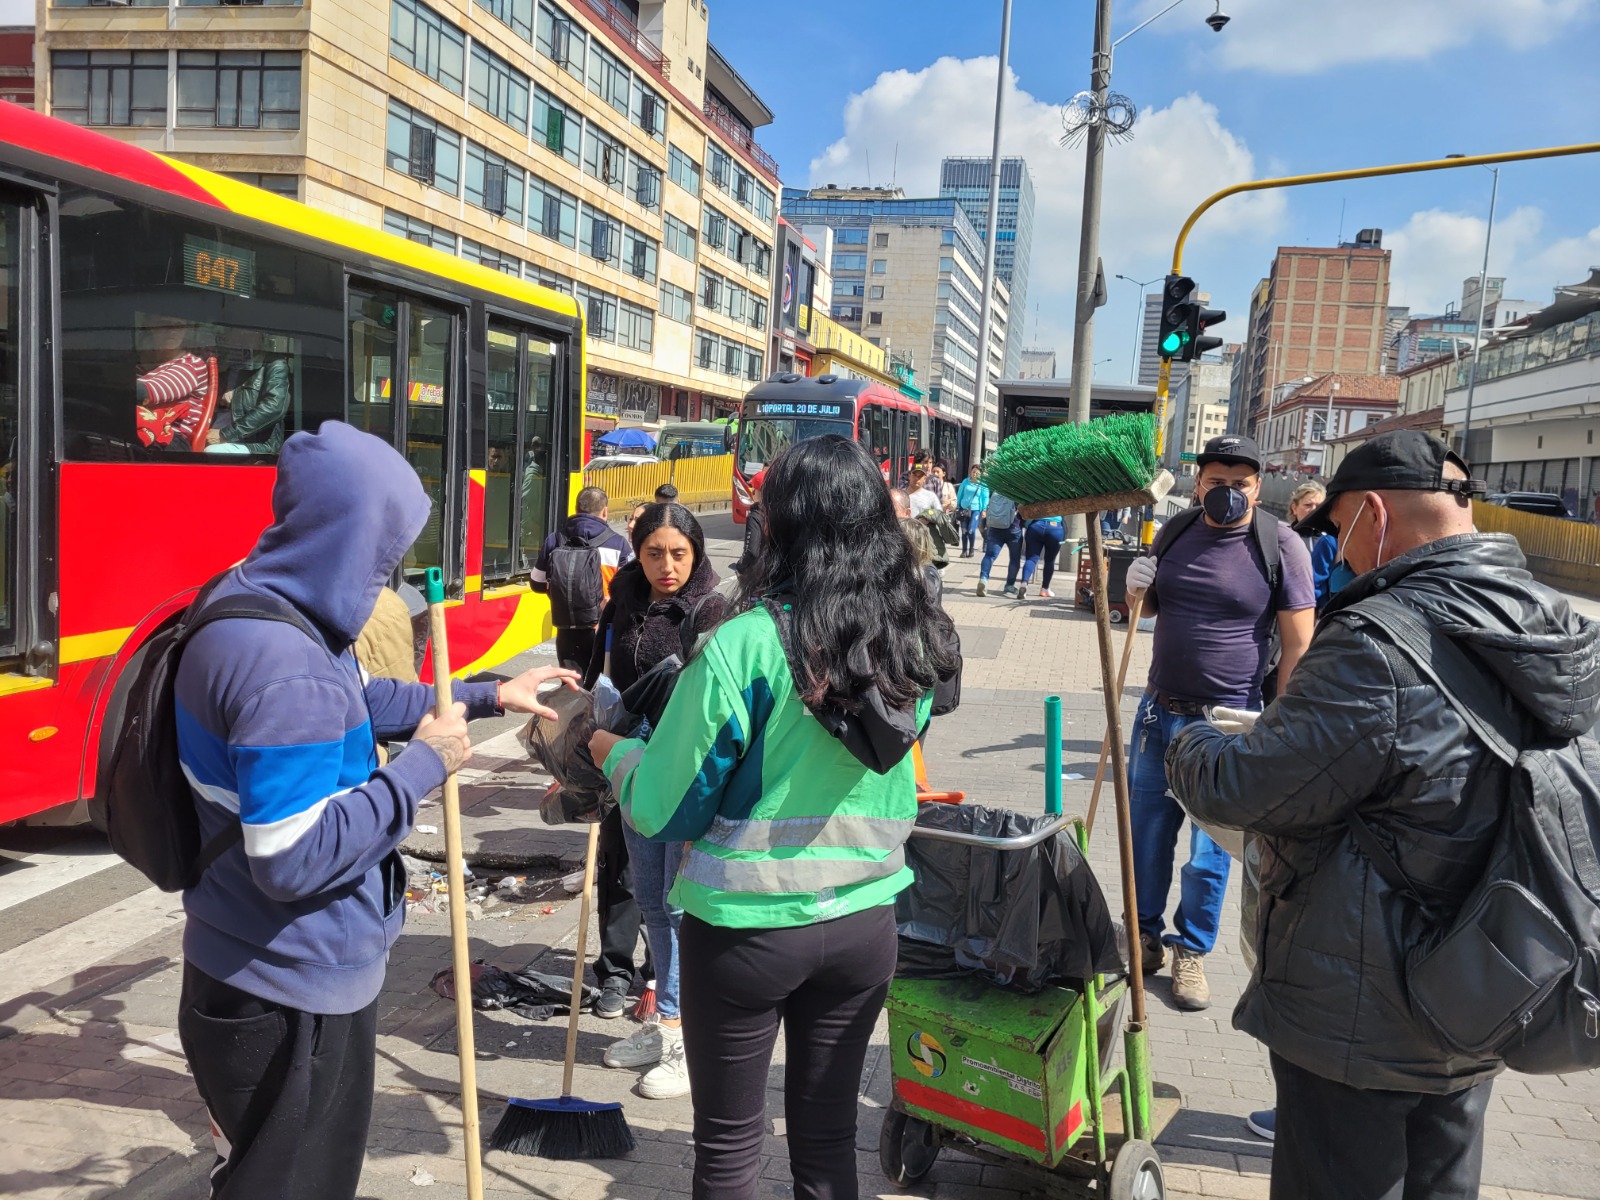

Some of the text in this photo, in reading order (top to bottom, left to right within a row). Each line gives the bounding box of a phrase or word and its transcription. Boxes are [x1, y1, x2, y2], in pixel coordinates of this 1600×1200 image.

[196, 251, 239, 290] G47
[621, 412, 643, 420] COSMOS
[797, 404, 807, 413] 20
[808, 404, 818, 413] DE
[819, 405, 840, 414] JULIO
[962, 1056, 1041, 1090] Promoambiental Distrito
